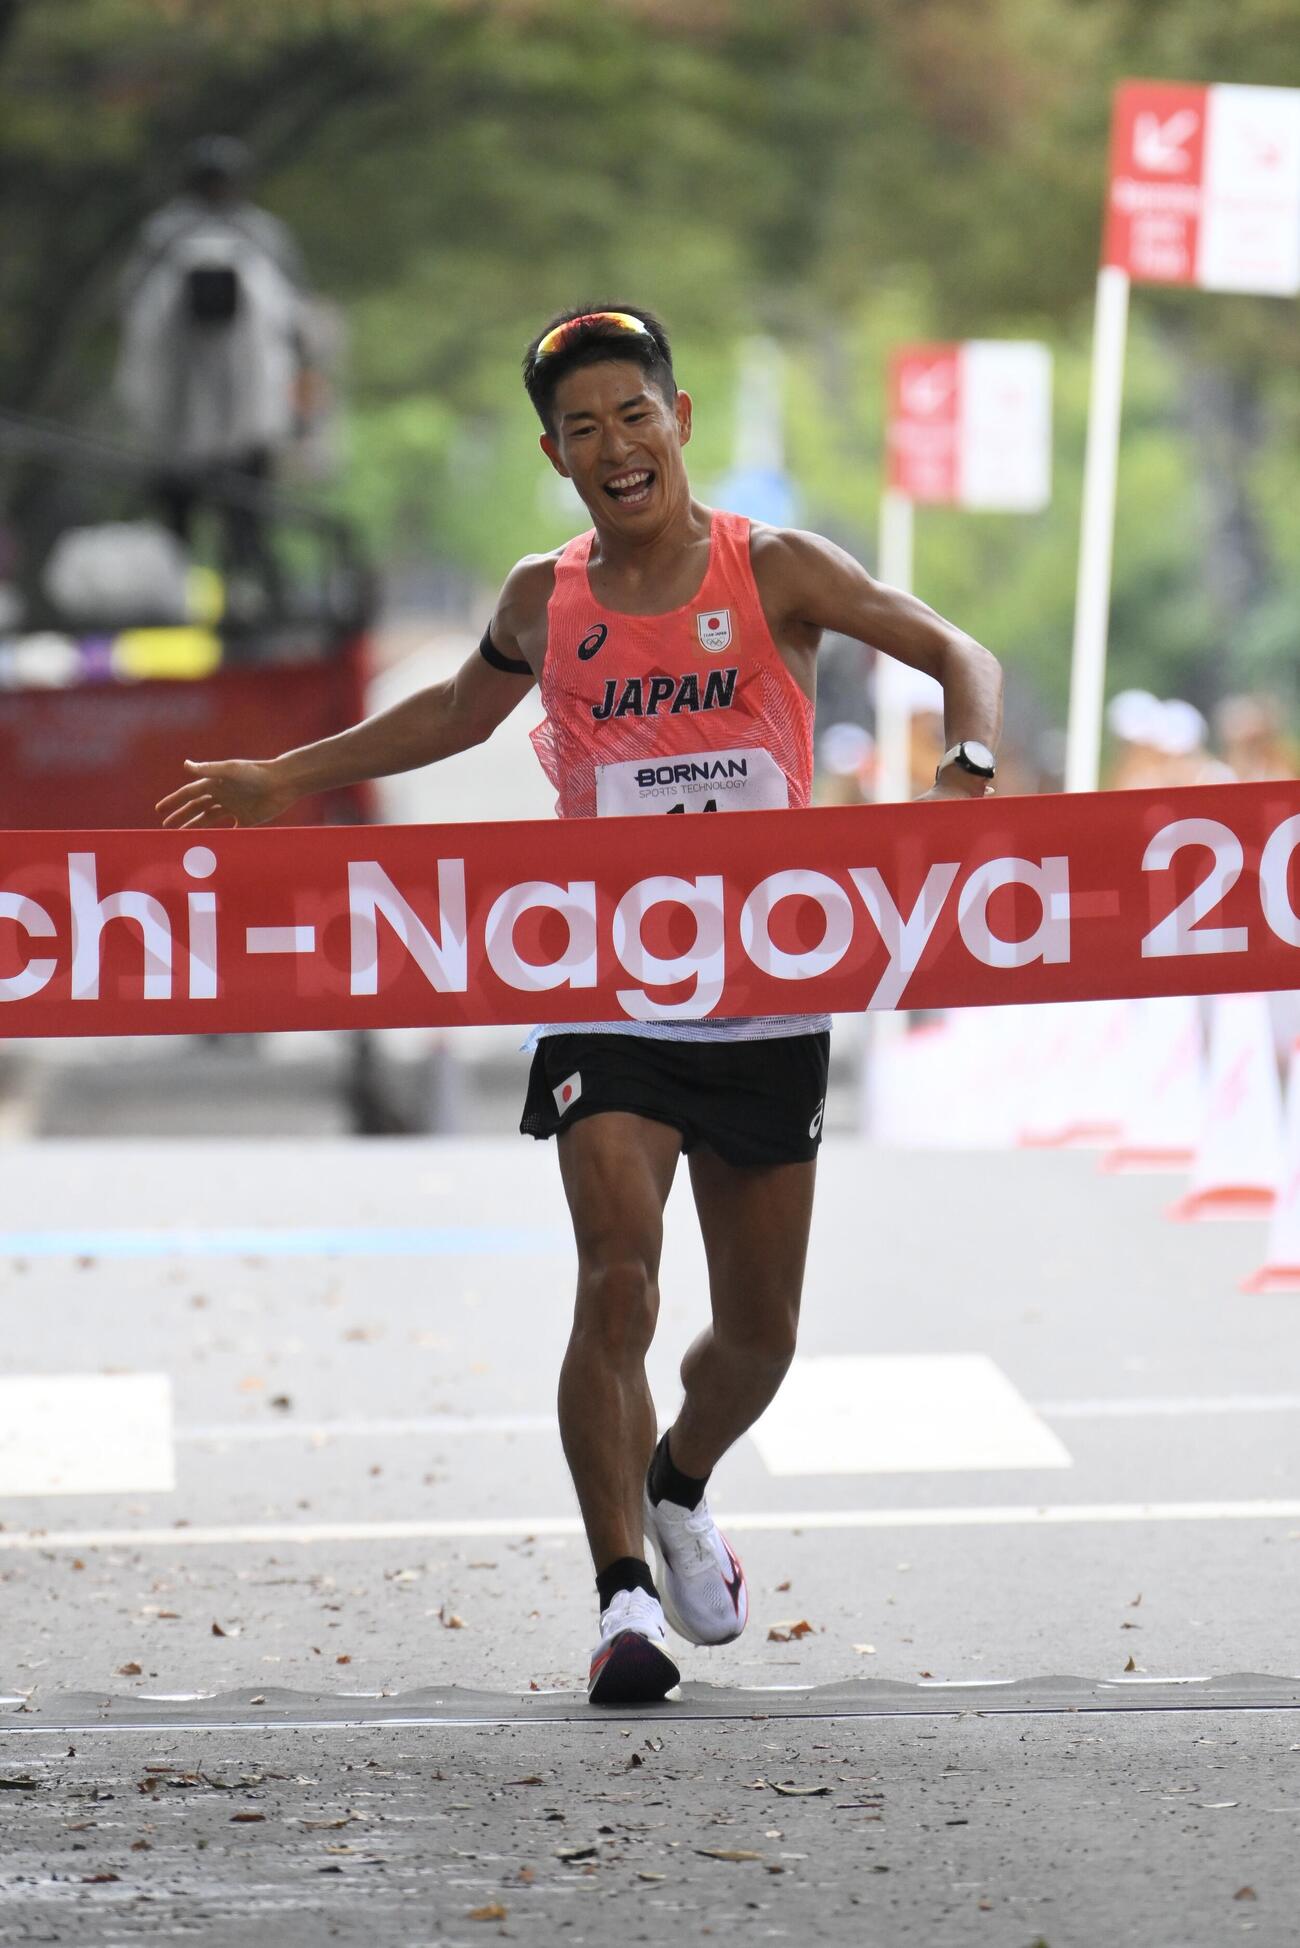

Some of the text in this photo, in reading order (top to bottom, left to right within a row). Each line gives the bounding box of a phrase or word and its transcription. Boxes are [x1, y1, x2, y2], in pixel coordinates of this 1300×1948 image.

[591, 668, 738, 720] JAPAN
[634, 758, 748, 787] BORNAN
[639, 779, 748, 799] SPORTS TECHNOLOGY
